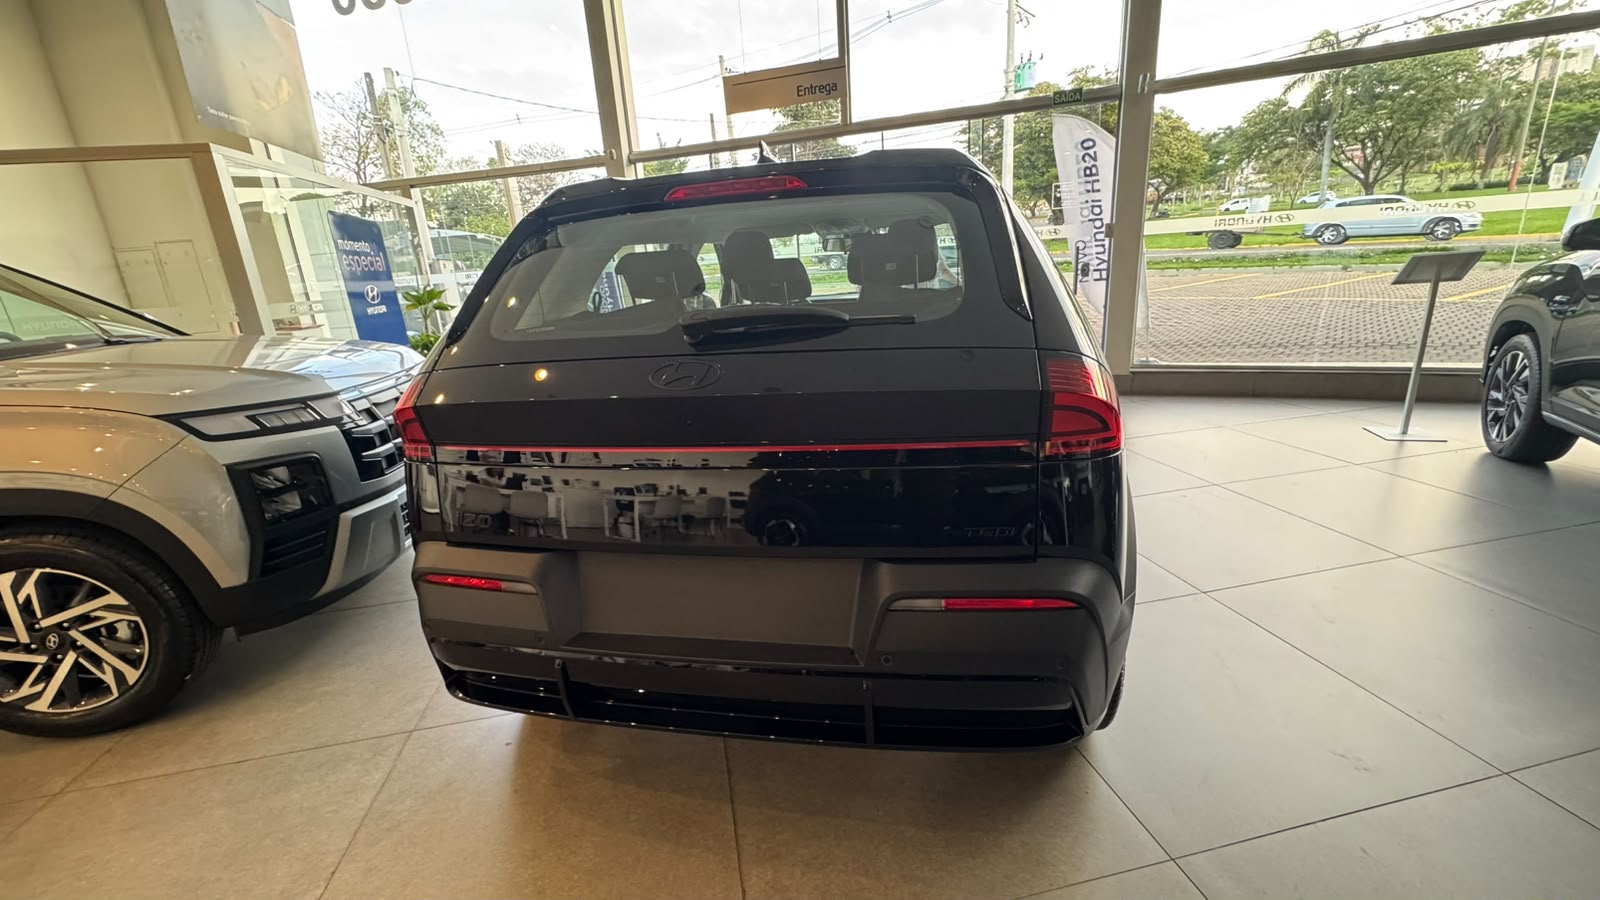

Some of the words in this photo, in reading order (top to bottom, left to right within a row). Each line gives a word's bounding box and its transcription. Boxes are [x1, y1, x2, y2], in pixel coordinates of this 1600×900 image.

[796, 82, 838, 97] Entrega
[1080, 137, 1102, 193] HB20
[337, 239, 371, 252] momento
[1085, 199, 1109, 282] Hyundai
[342, 250, 386, 276] especial
[1075, 240, 1090, 283] NVO
